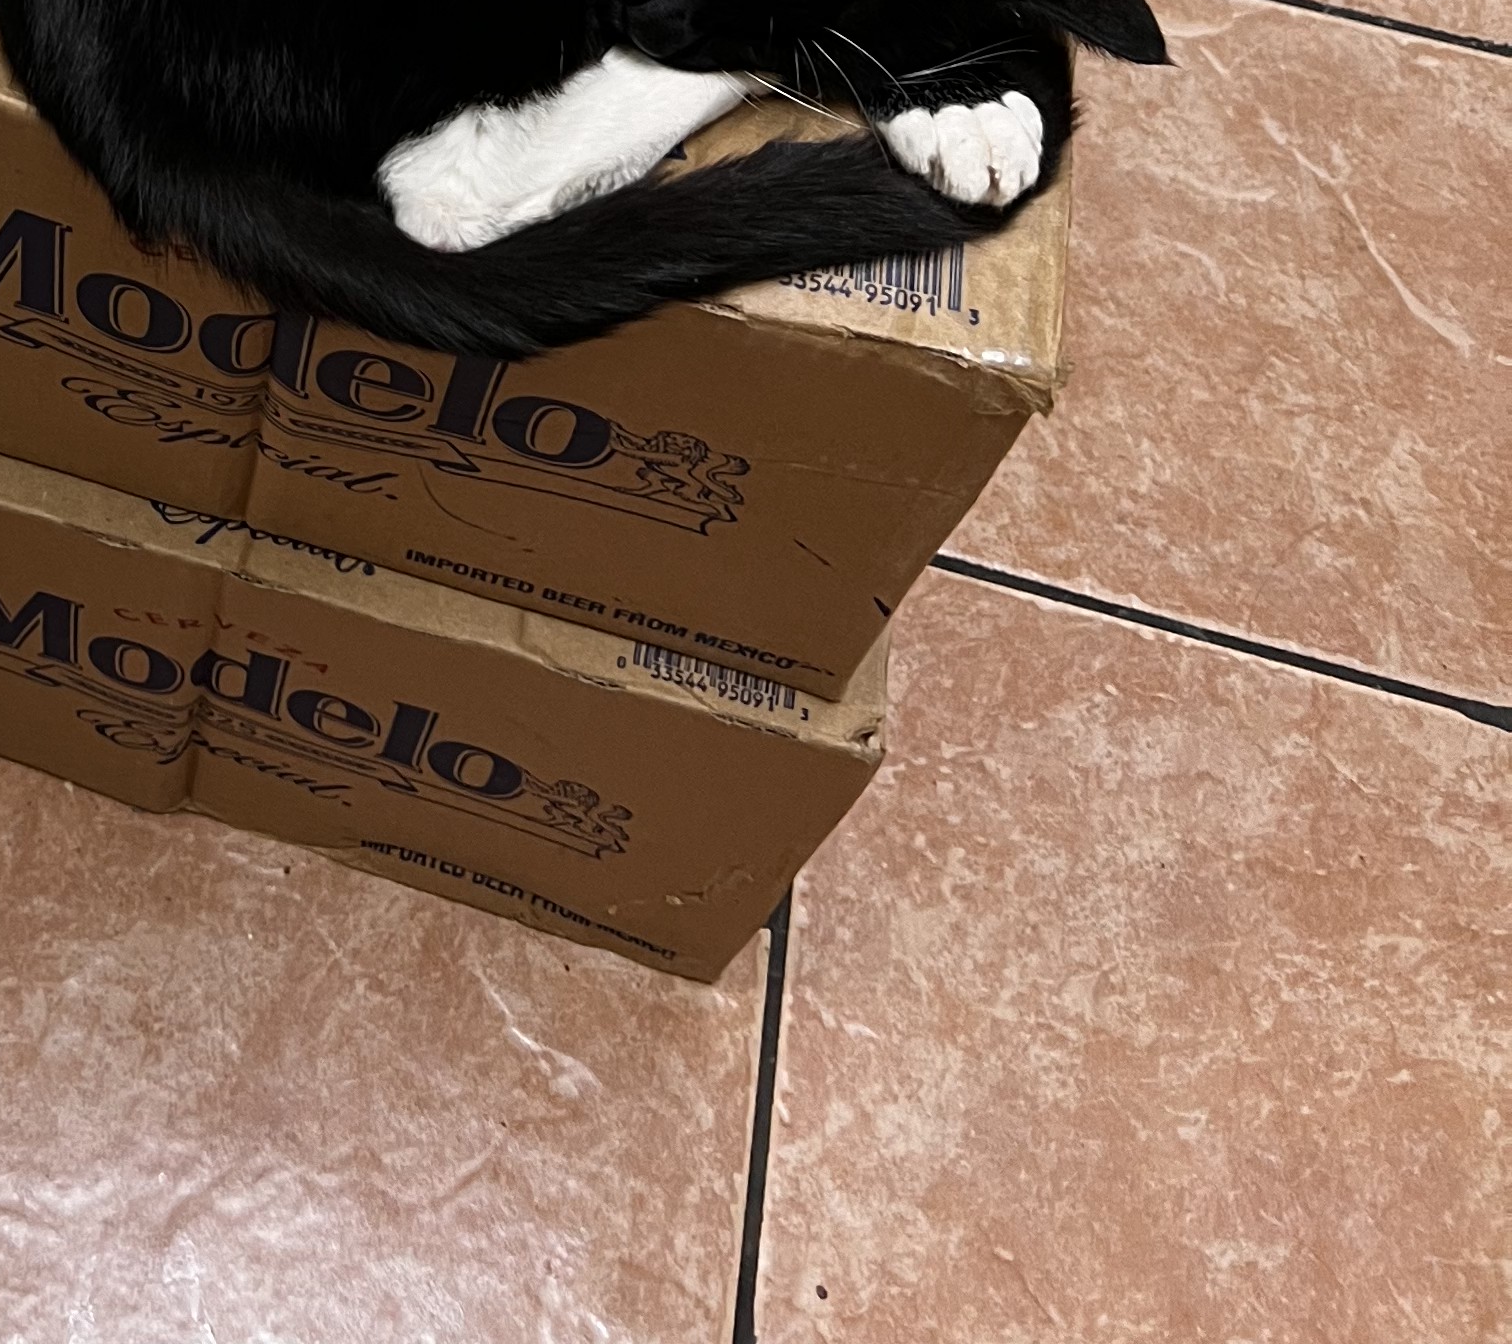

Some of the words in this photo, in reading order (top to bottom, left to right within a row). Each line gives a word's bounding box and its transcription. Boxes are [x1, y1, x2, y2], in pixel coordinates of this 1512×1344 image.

[864, 283, 938, 317] 95091
[968, 308, 981, 326] 3
[405, 547, 536, 596] IMPORTED
[541, 586, 607, 617] BEER
[612, 606, 690, 640] FROM
[693, 630, 798, 672] MEXICO
[617, 655, 627, 670] 0
[648, 660, 709, 694] 33544
[716, 678, 776, 712] 95091
[800, 707, 810, 722] 3
